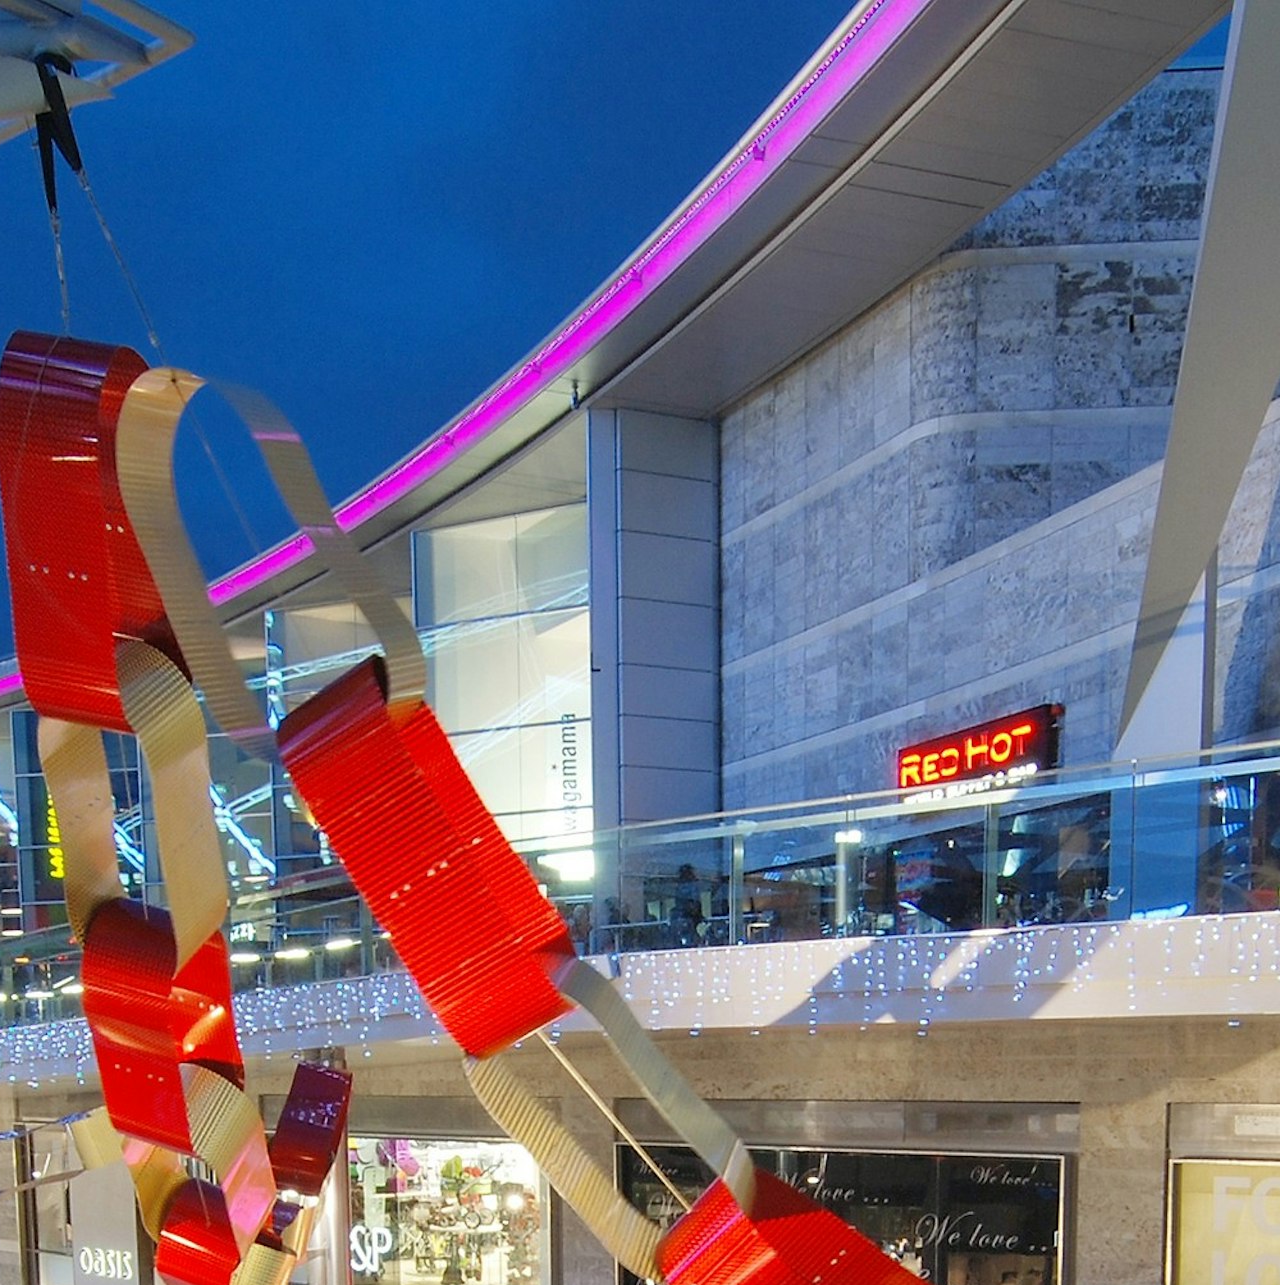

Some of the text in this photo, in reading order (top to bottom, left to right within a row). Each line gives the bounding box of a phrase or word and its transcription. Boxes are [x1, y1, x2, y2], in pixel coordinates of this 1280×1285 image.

[561, 712, 582, 832] wagamama
[900, 724, 1032, 787] RED HOT
[970, 1163, 1000, 1185] We
[349, 1224, 393, 1273] &P
[915, 1211, 975, 1247] We
[969, 1223, 1020, 1251] love
